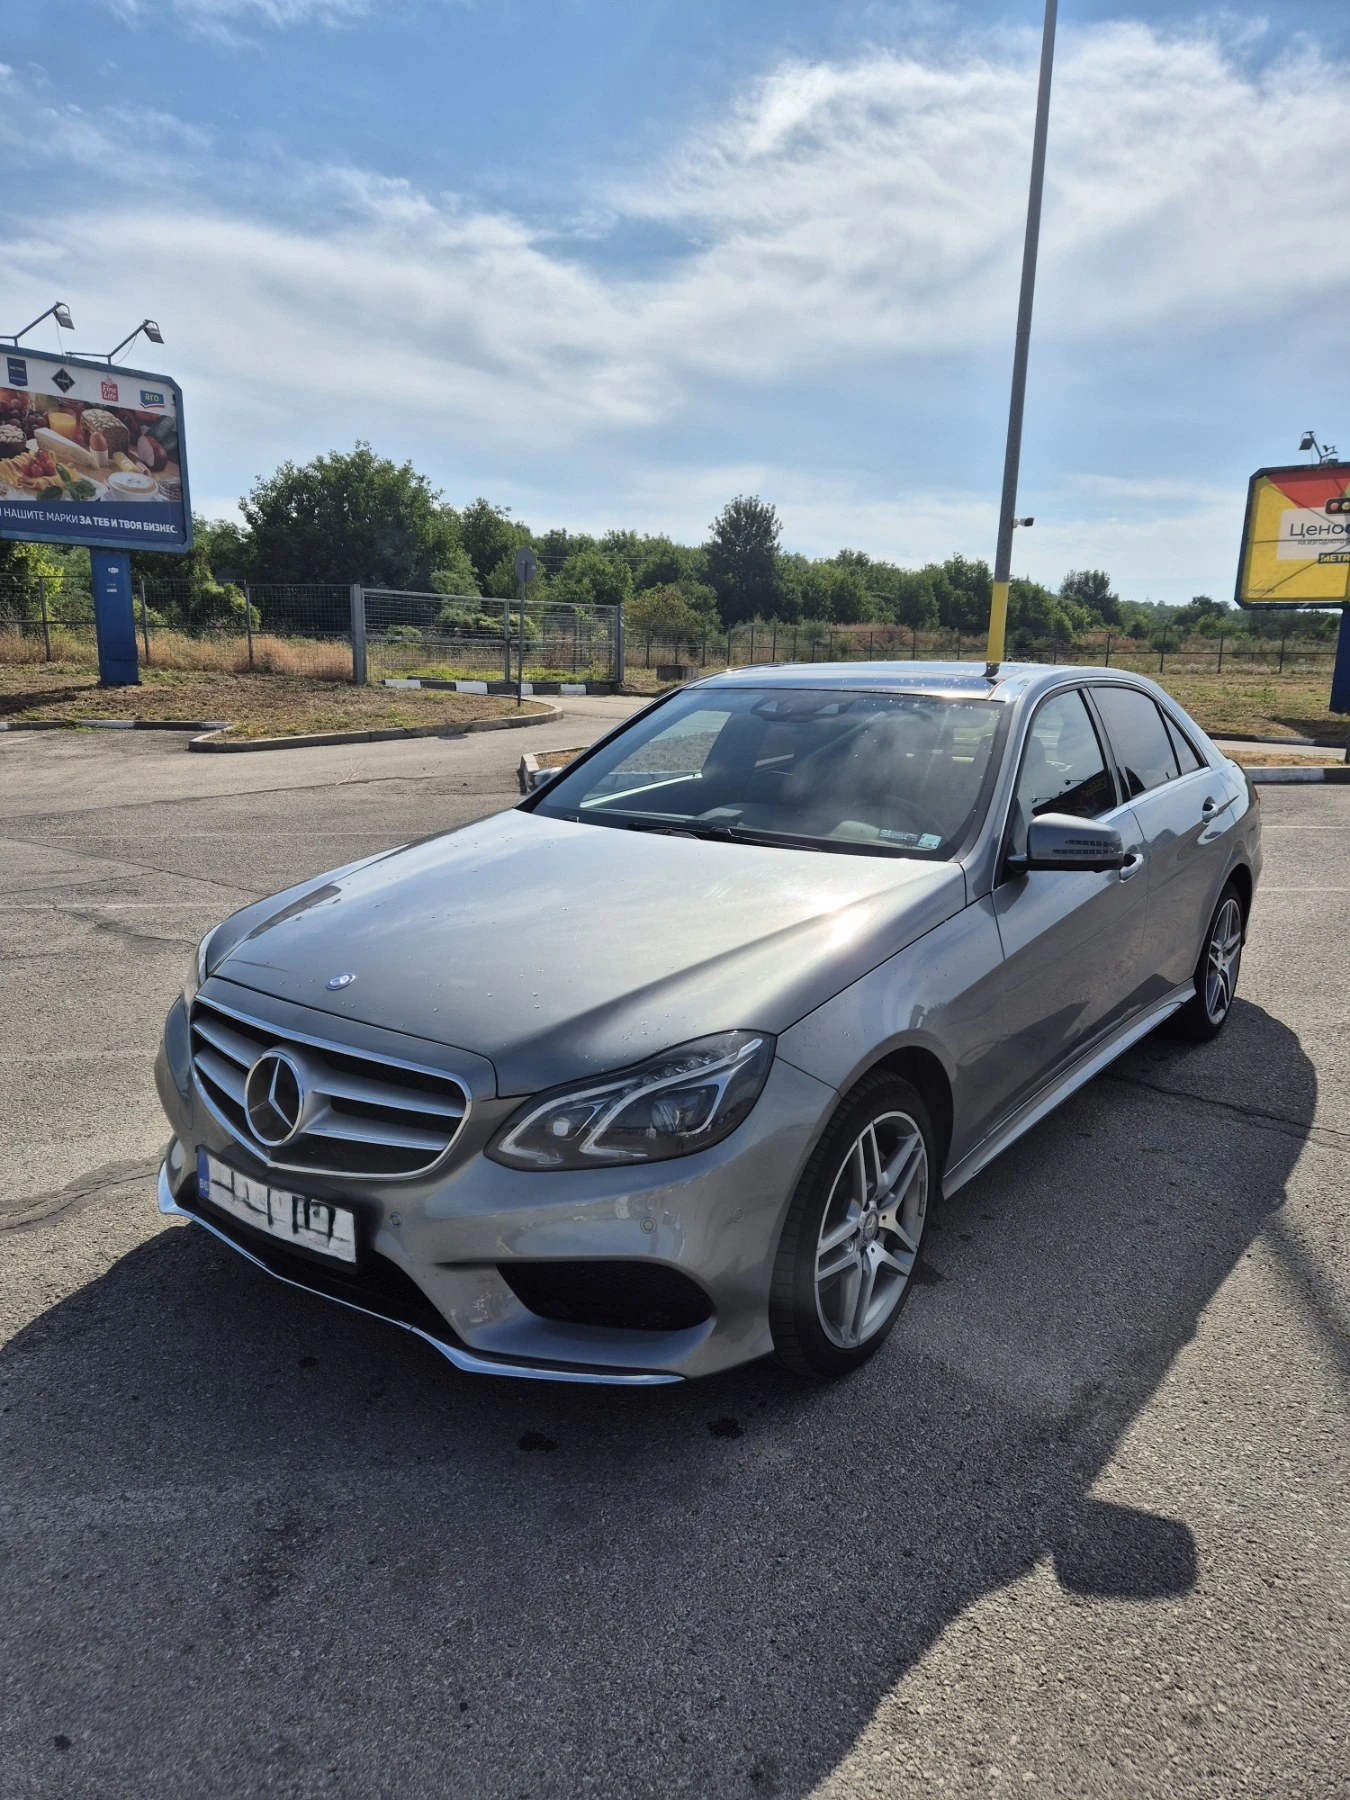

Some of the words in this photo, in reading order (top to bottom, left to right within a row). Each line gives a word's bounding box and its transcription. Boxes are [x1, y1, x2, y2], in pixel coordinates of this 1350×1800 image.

[103, 391, 117, 401] Life
[144, 393, 159, 402] aro
[3, 507, 45, 521] НАШИТЕ
[46, 511, 78, 524] МАРКИ
[79, 515, 92, 526] ЗА
[92, 516, 110, 527] ТЕБ
[111, 518, 117, 528] И
[118, 519, 142, 530] ТВОЯ
[143, 522, 178, 534] БИЗНЕС.
